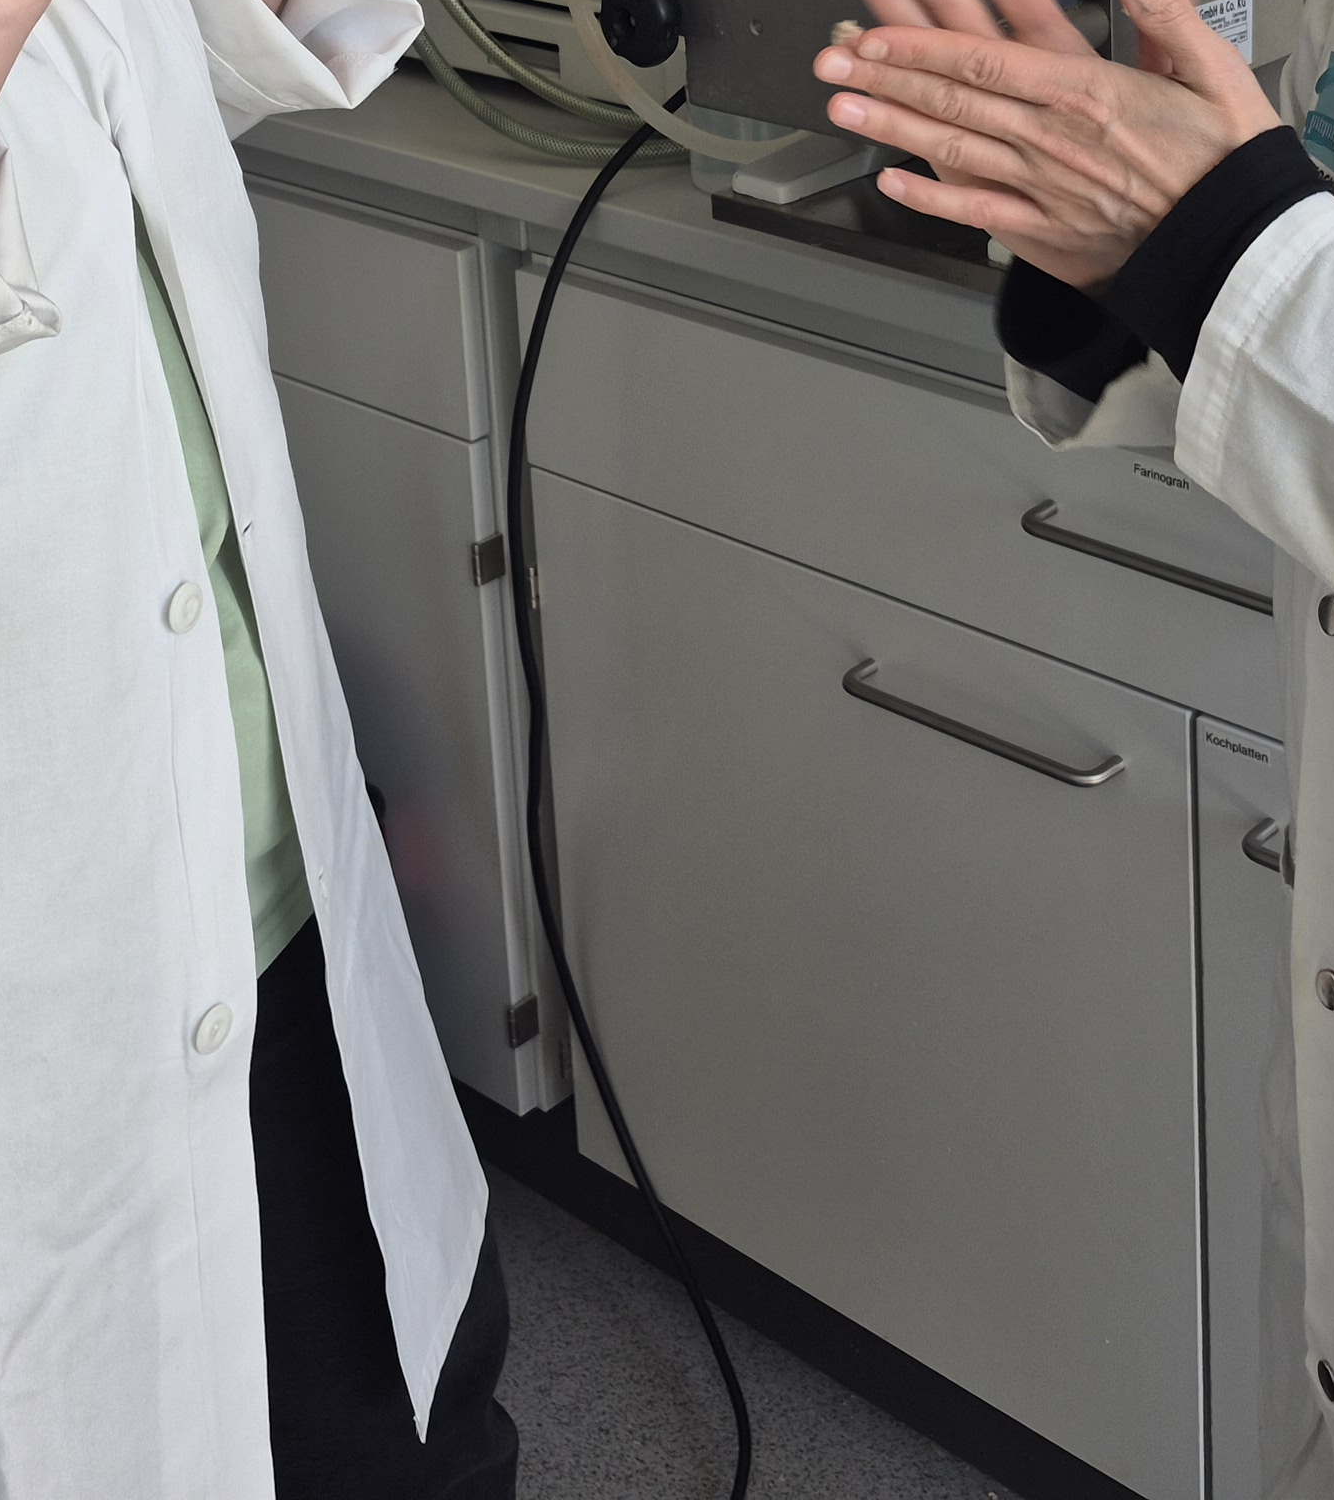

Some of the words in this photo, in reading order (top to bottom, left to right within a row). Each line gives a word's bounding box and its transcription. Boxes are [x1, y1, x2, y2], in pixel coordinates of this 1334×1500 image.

[1199, 5, 1218, 20] GmbH
[1133, 463, 1190, 490] Farinograh
[1205, 731, 1269, 763] Kochplatten
